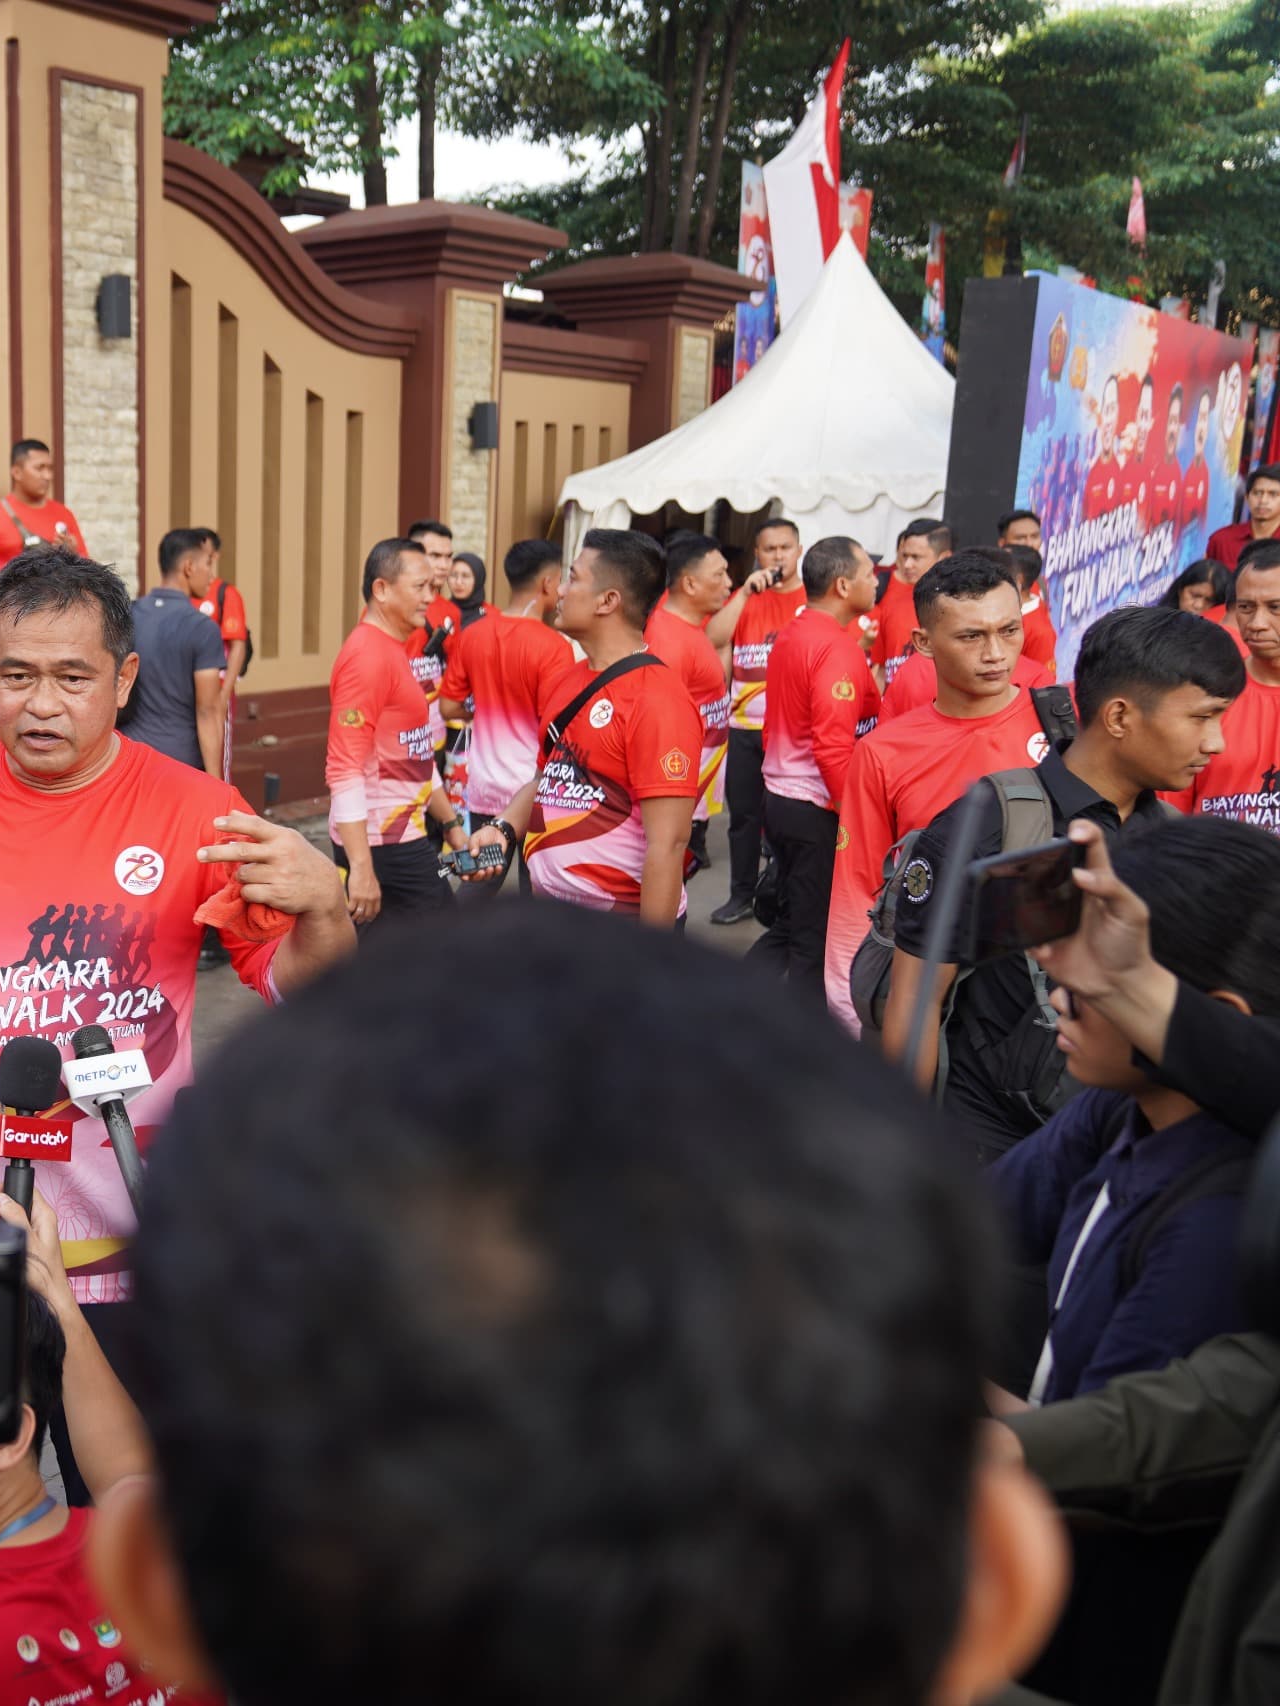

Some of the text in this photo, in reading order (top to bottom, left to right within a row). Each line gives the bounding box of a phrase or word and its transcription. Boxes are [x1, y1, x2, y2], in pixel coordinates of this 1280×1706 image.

[1060, 520, 1174, 629] FUN WALK 2024
[408, 738, 429, 760] FUN
[563, 781, 606, 803] 2024
[96, 983, 165, 1024] 2024
